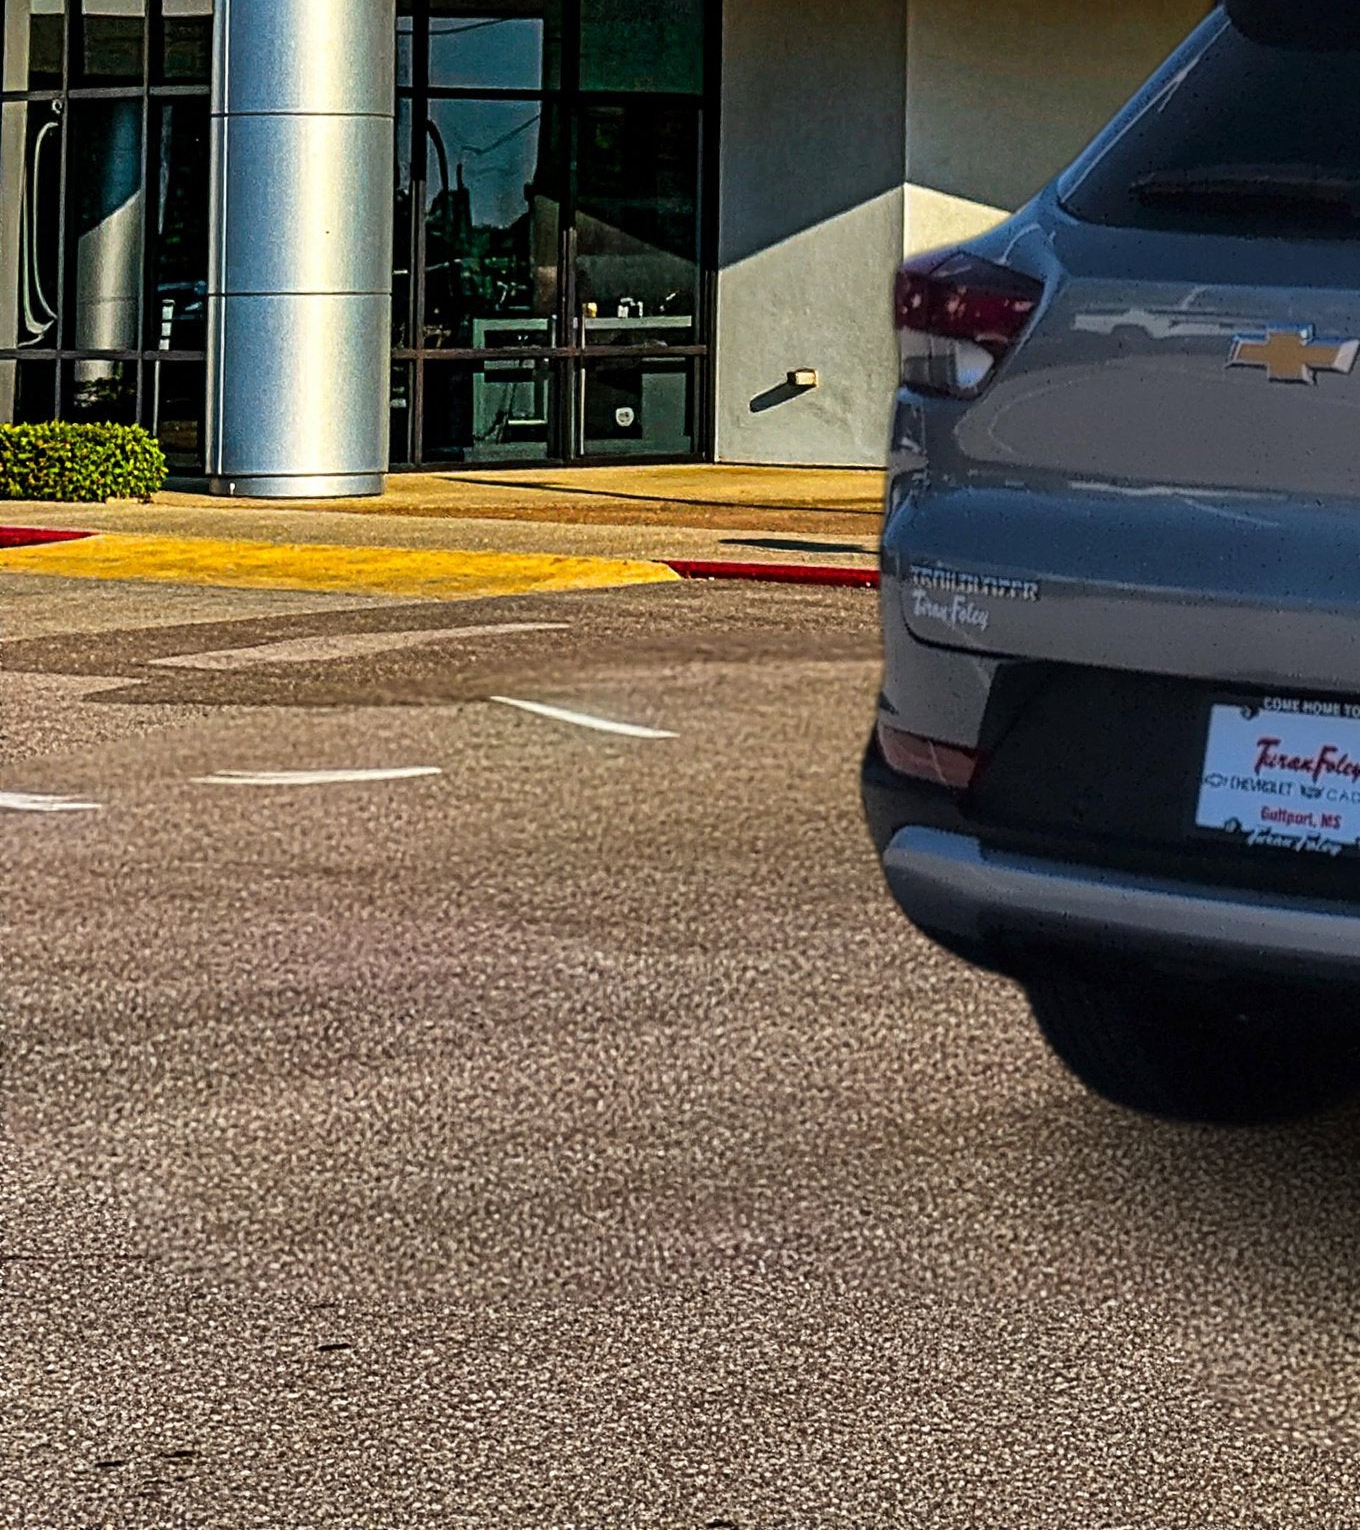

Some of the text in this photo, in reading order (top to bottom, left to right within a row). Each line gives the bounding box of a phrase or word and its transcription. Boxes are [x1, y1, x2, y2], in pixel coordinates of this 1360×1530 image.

[1263, 696, 1299, 712] COME
[1302, 700, 1341, 716] HOME
[1320, 813, 1343, 830] MS
